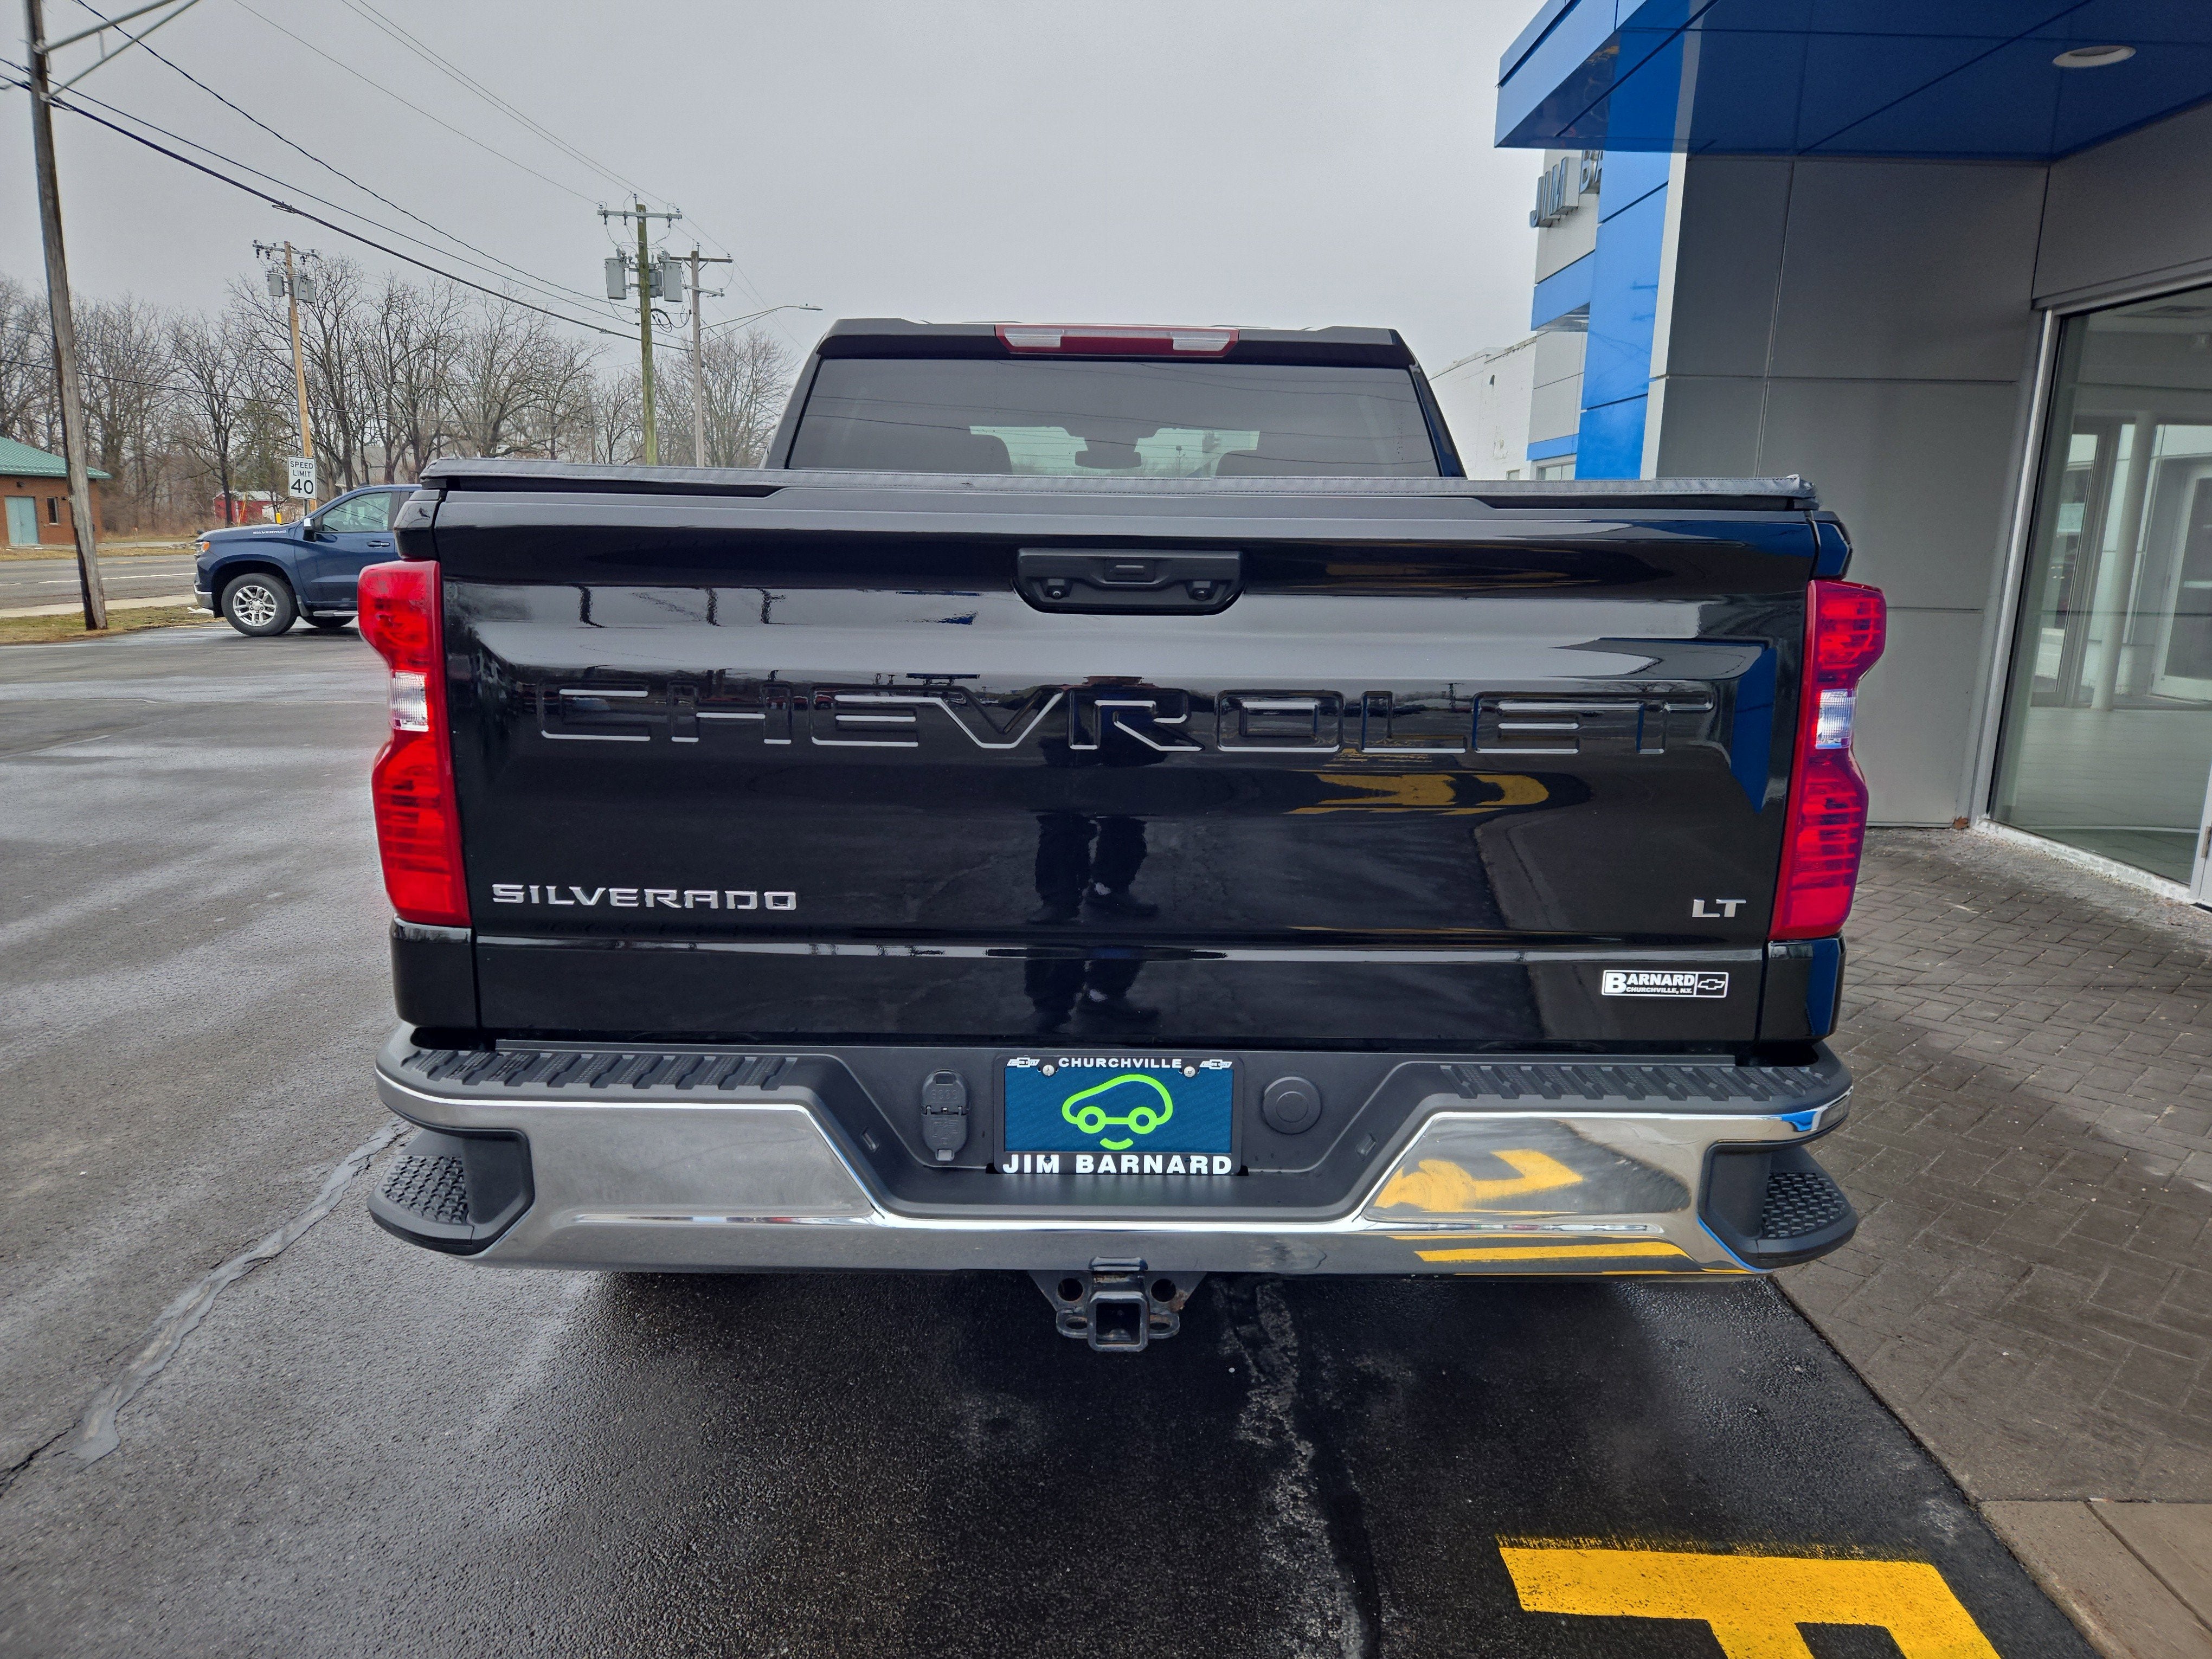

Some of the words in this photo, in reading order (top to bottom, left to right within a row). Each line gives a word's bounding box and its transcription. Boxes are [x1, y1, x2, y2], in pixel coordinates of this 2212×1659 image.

[1529, 156, 1571, 228] JIM
[290, 461, 313, 469] SPEED
[291, 479, 314, 494] 40
[538, 679, 1715, 755] CHEVROLET
[491, 883, 798, 911] SILVERADO
[1692, 898, 1747, 918] LT
[1603, 972, 1695, 994] BARNARD
[1058, 1057, 1182, 1069] CHURCHVILLE
[1002, 1154, 1060, 1174] JIM
[1076, 1154, 1232, 1175] BARNARD
